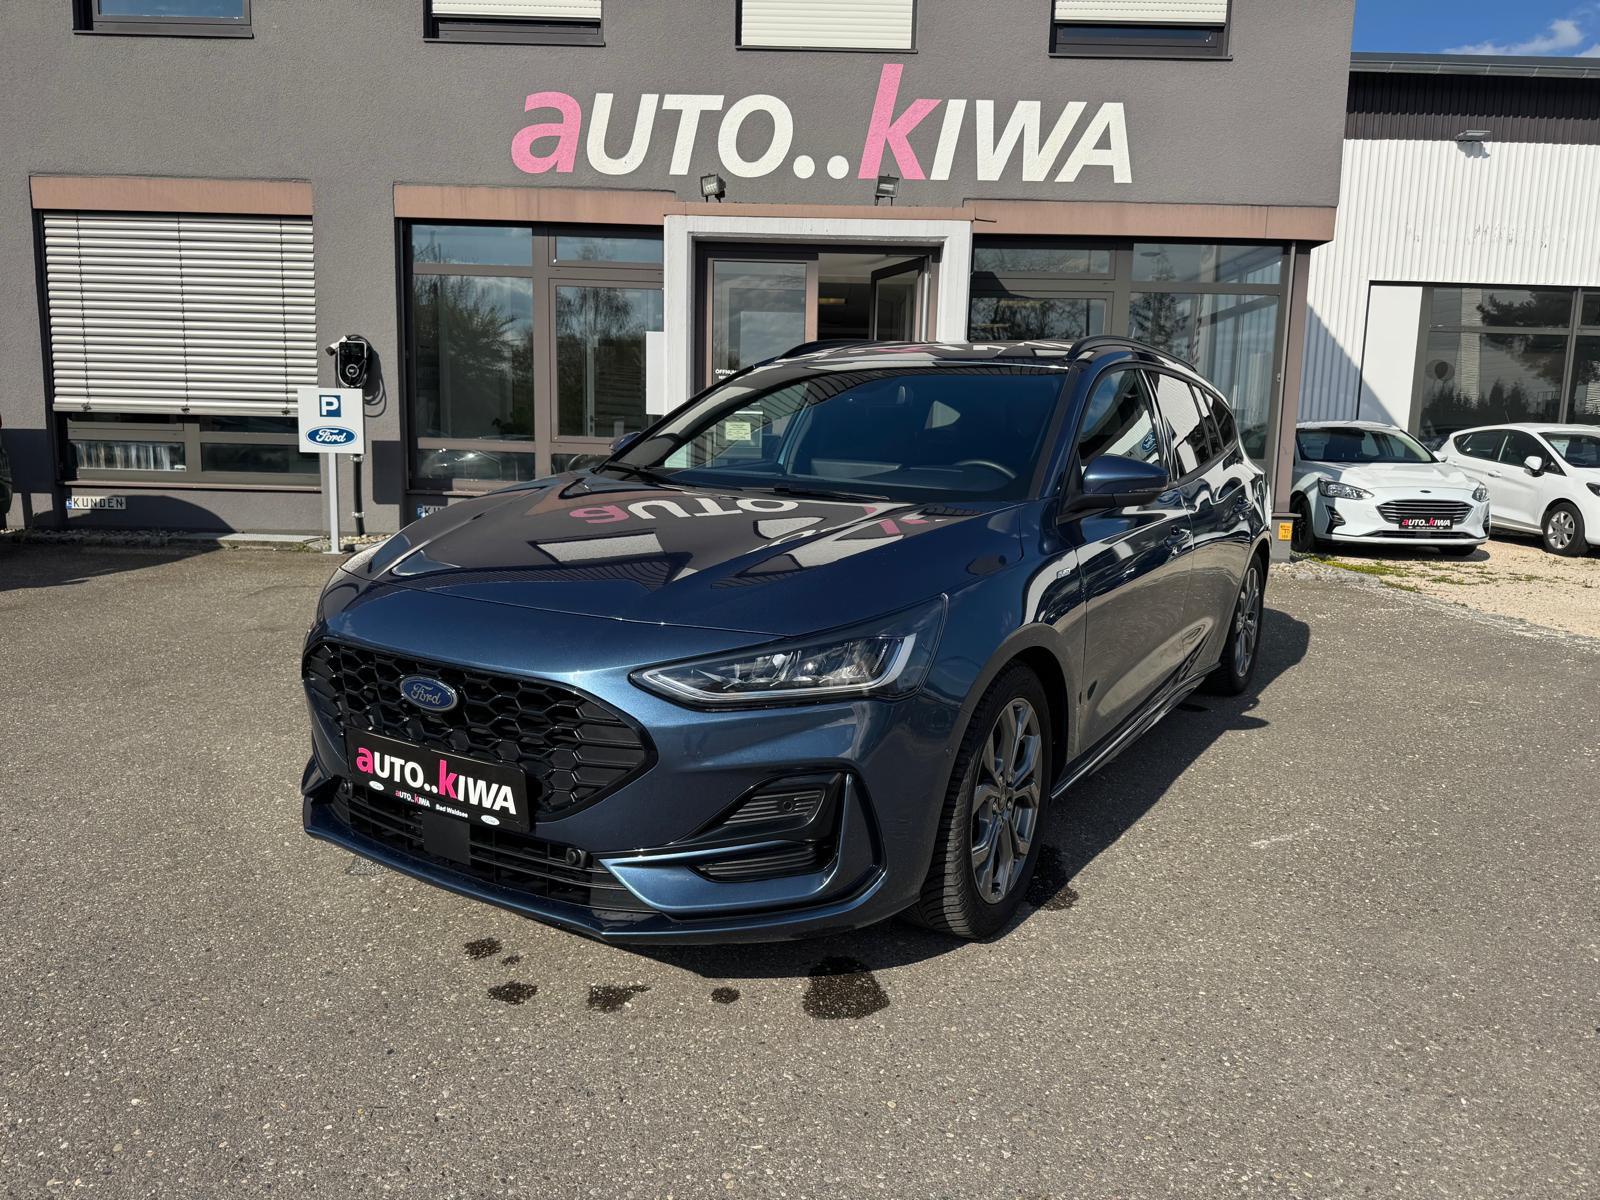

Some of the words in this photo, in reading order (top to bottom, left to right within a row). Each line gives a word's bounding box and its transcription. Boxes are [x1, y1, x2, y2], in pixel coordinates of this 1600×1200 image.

[321, 396, 339, 416] P
[315, 428, 347, 442] Ford
[73, 497, 124, 508] KUNDEN
[410, 684, 442, 705] Ford
[435, 804, 447, 813] Bad
[446, 806, 469, 818] Waldsee
